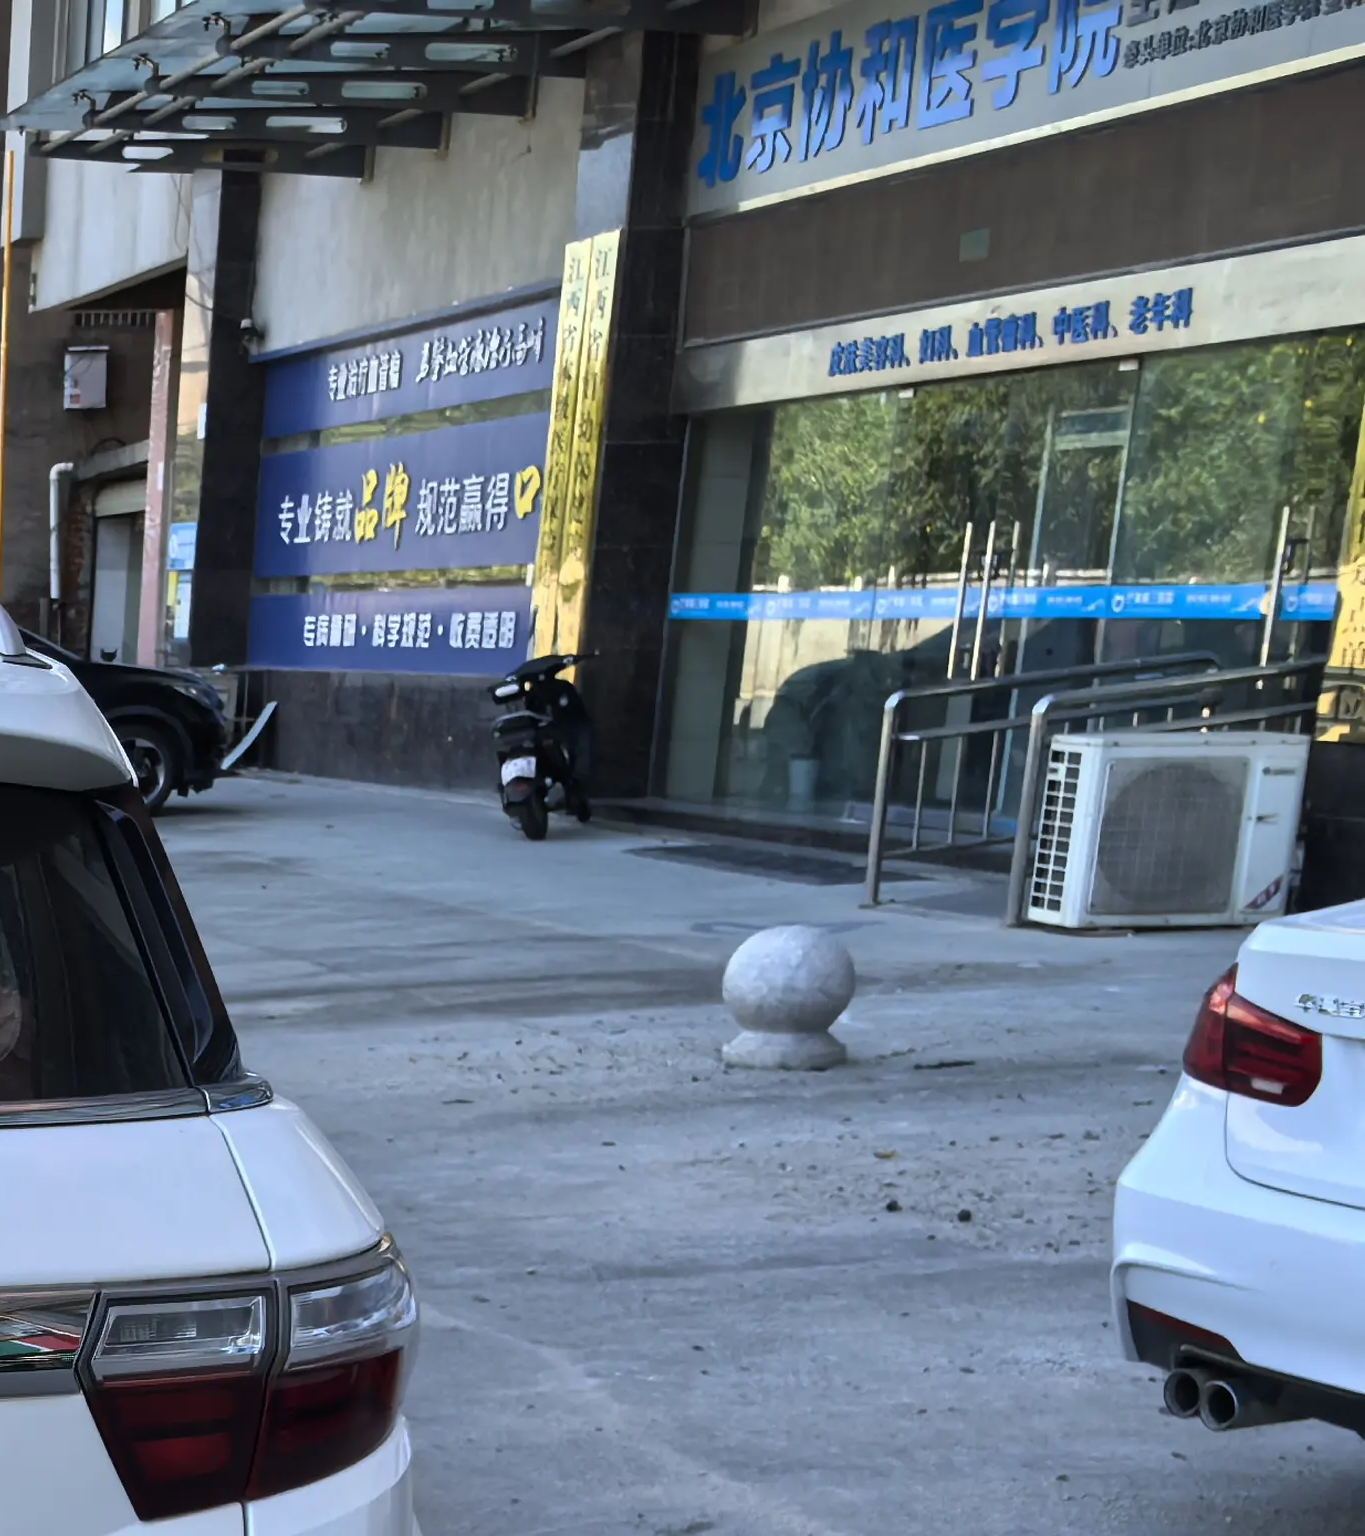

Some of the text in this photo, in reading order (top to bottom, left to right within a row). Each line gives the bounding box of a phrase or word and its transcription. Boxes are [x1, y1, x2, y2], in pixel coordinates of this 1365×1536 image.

[696, 0, 1124, 189] 北京协和医学院
[278, 461, 410, 549] 专业铸就品牌
